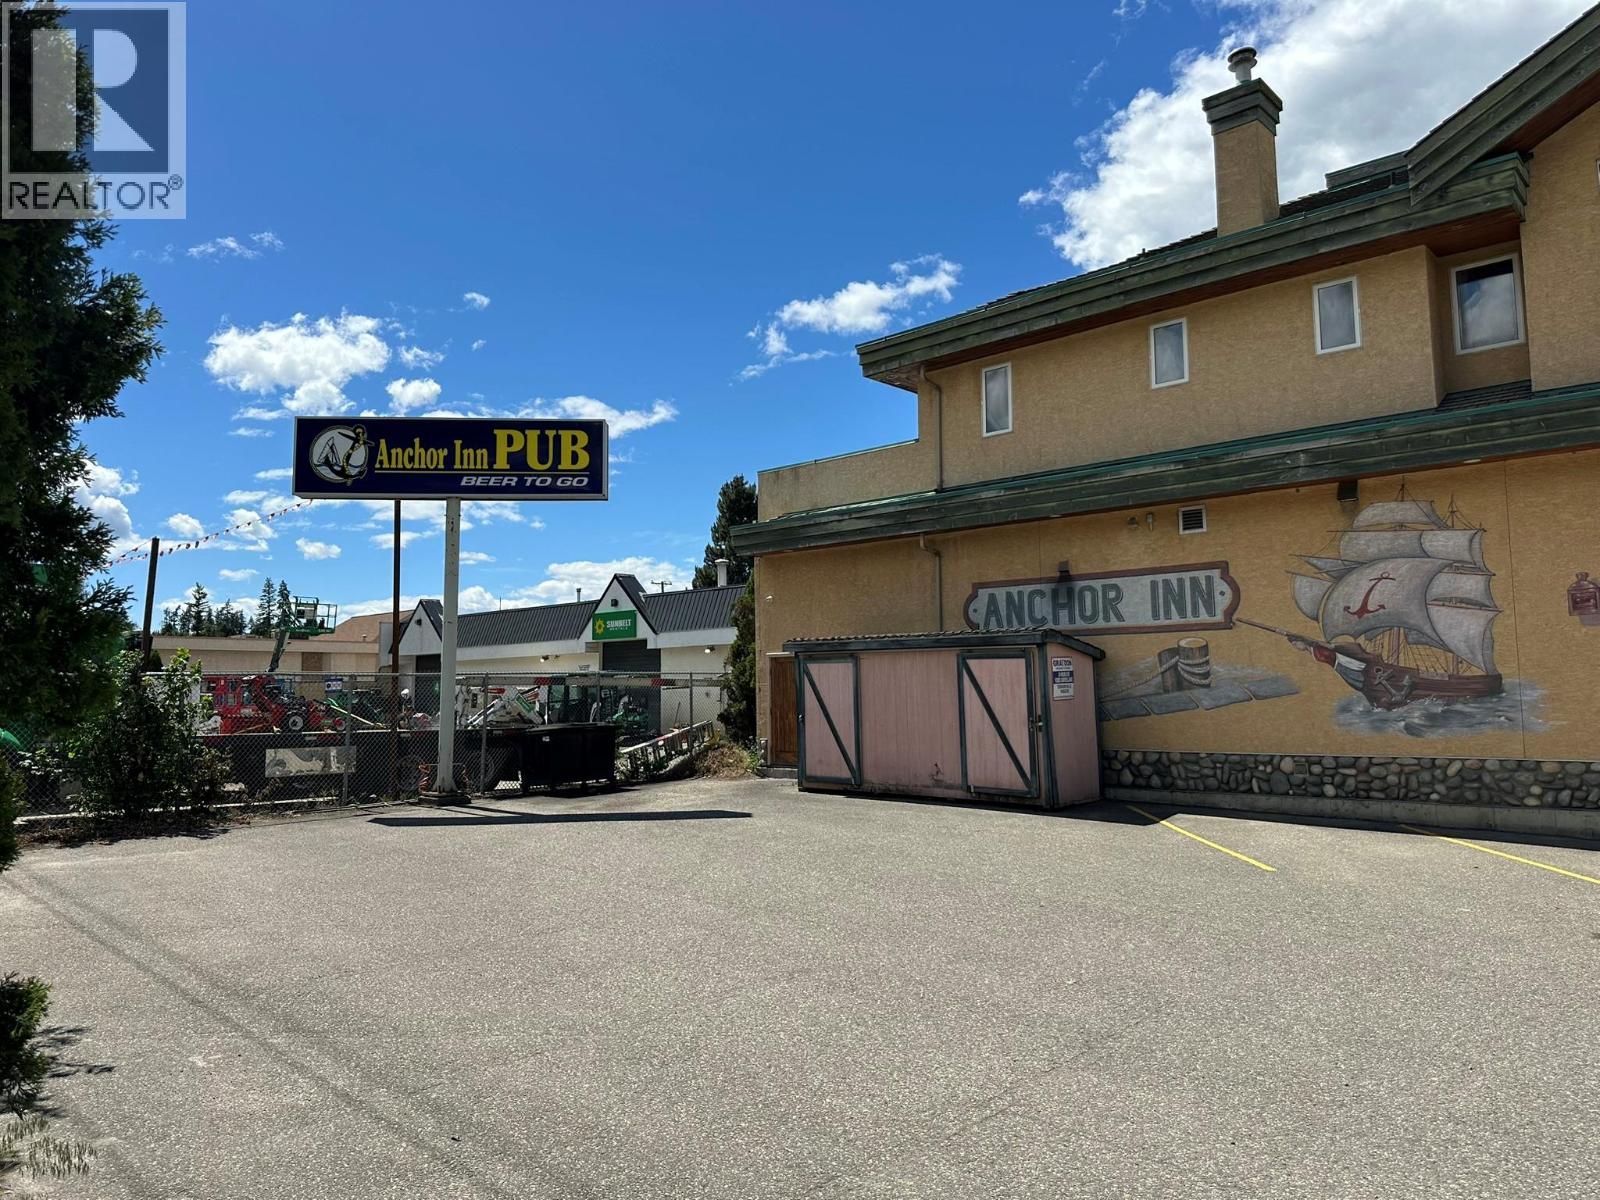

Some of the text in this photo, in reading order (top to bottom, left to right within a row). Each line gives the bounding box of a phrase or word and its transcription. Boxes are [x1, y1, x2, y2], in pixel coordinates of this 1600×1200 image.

[375, 429, 590, 470] Anchor Inn PUB
[460, 475, 589, 487] BEER TO GO
[983, 575, 1216, 630] ANCHOR INN
